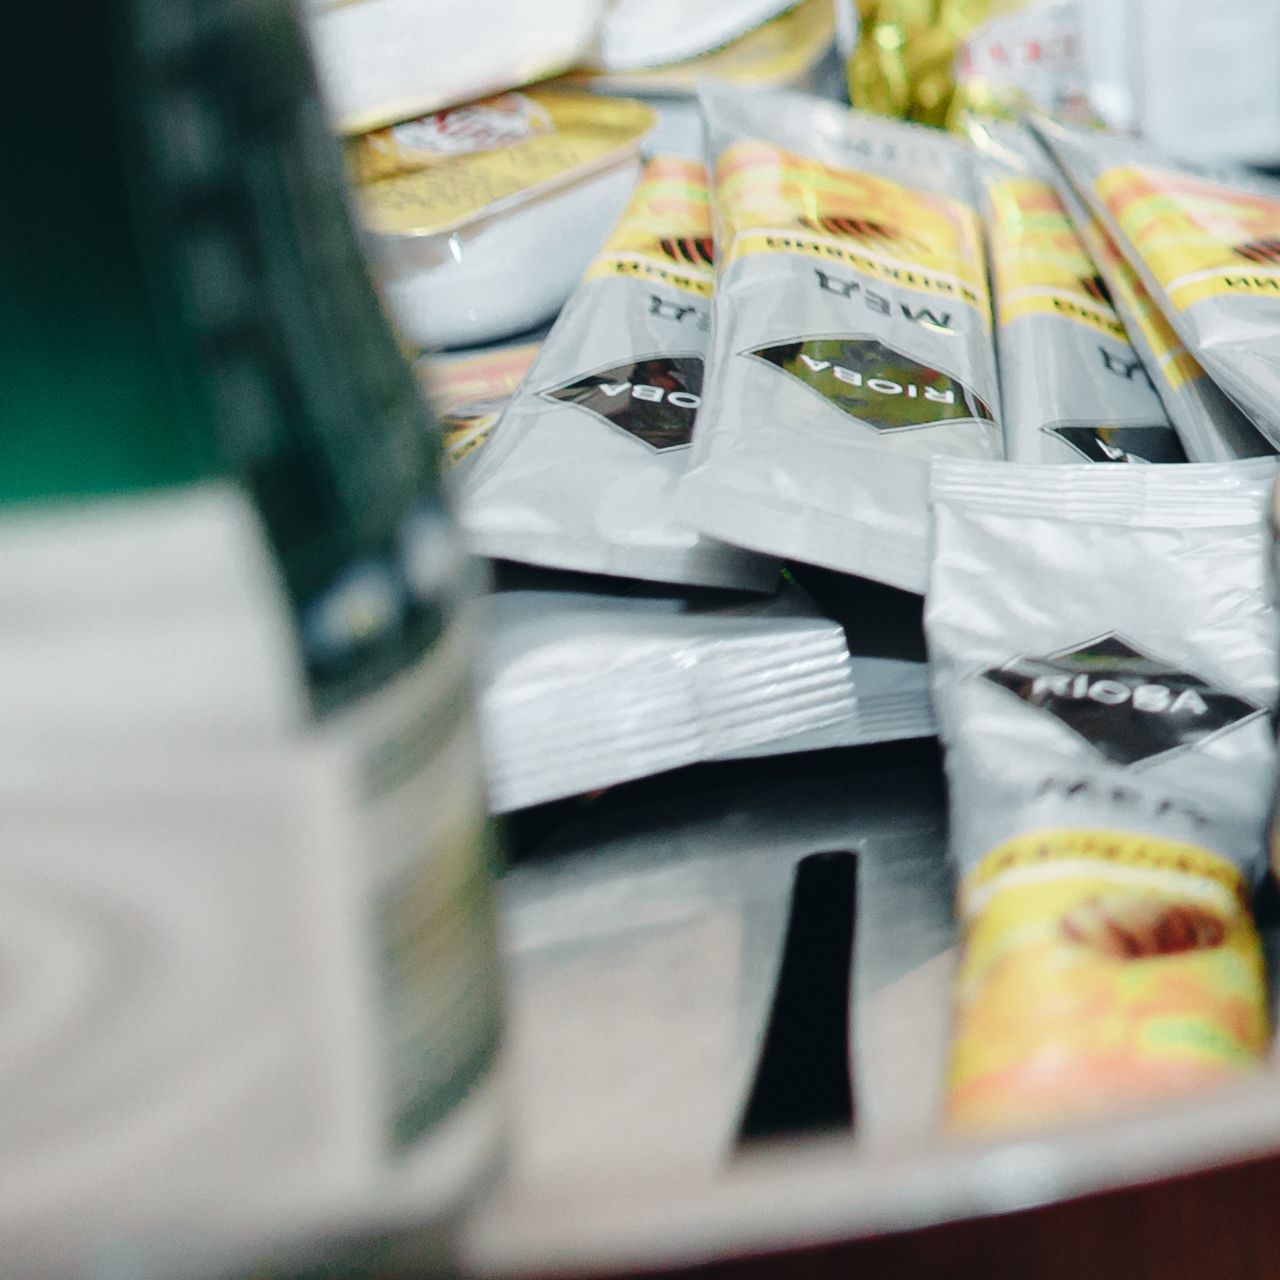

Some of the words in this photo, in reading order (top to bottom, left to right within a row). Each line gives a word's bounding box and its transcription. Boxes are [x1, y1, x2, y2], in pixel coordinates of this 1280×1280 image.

[814, 268, 956, 333] МЕД
[598, 381, 702, 410] OBA
[799, 353, 956, 405] RIOBA
[1031, 672, 1209, 716] RIOBA
